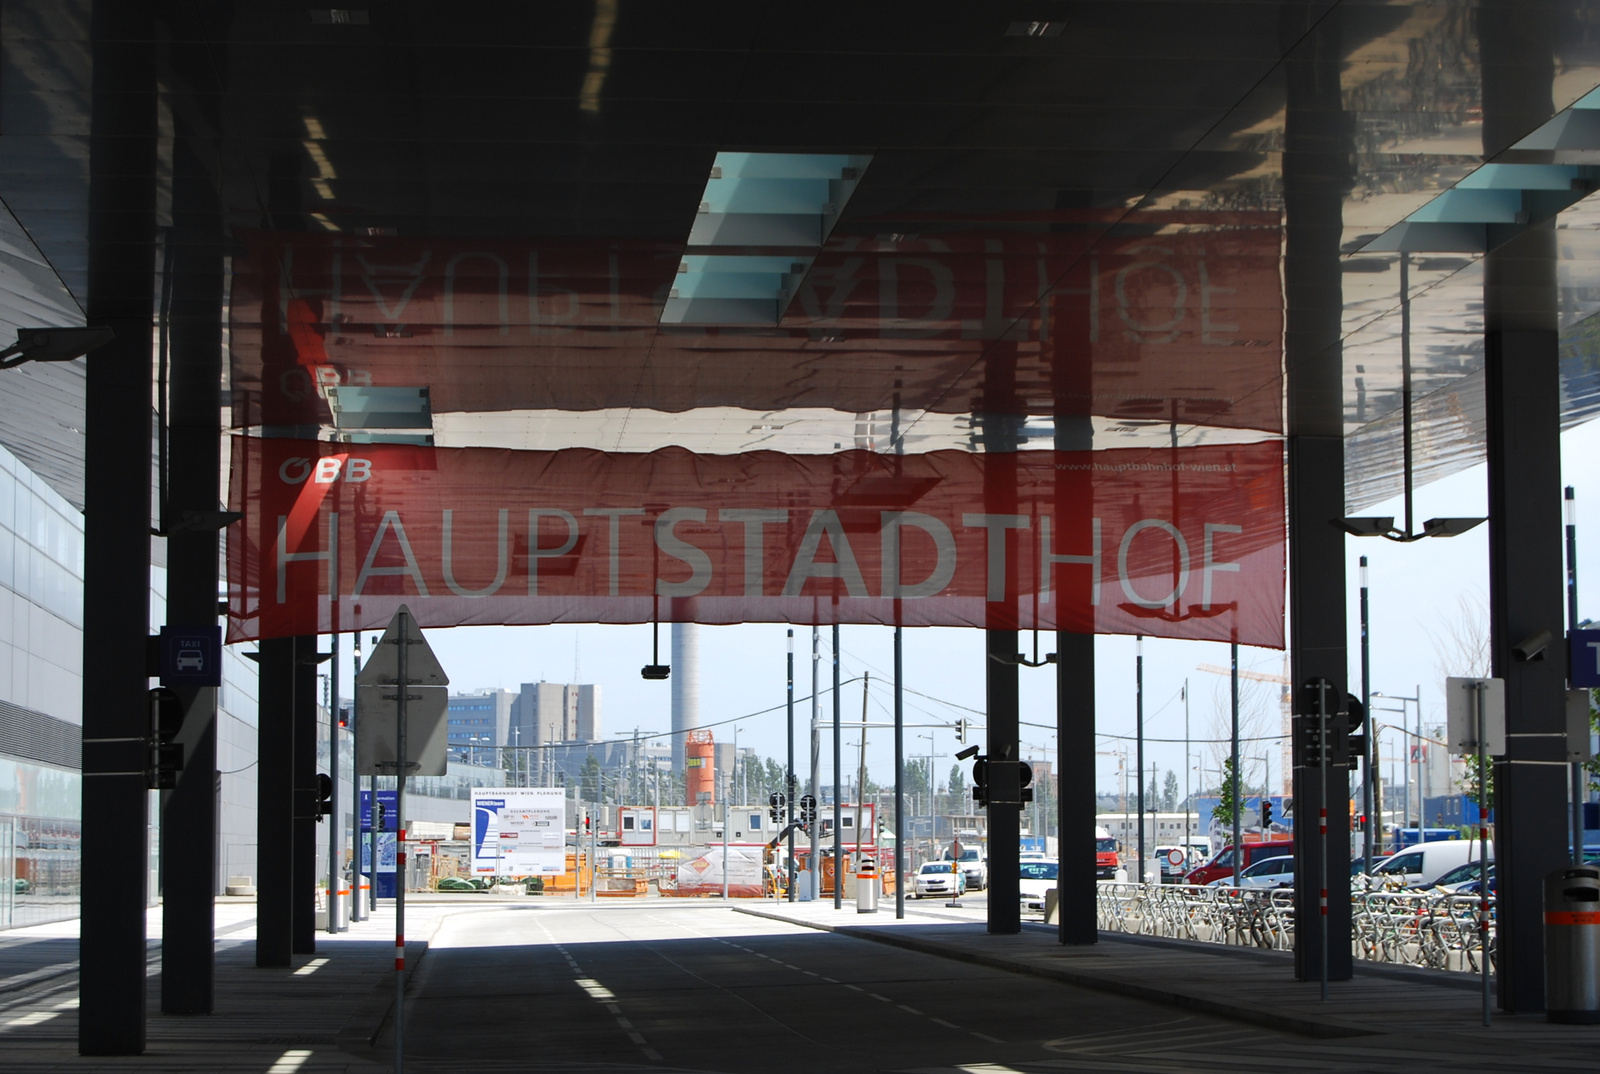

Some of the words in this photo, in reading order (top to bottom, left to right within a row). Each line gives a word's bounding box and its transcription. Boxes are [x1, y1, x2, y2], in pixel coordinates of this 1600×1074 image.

[278, 457, 372, 484] ÖBB
[1054, 462, 1238, 473] www.hauptbahnhof-wien.at
[276, 507, 1243, 611] HAUPTSTADTHOF
[180, 640, 200, 648] TAXI
